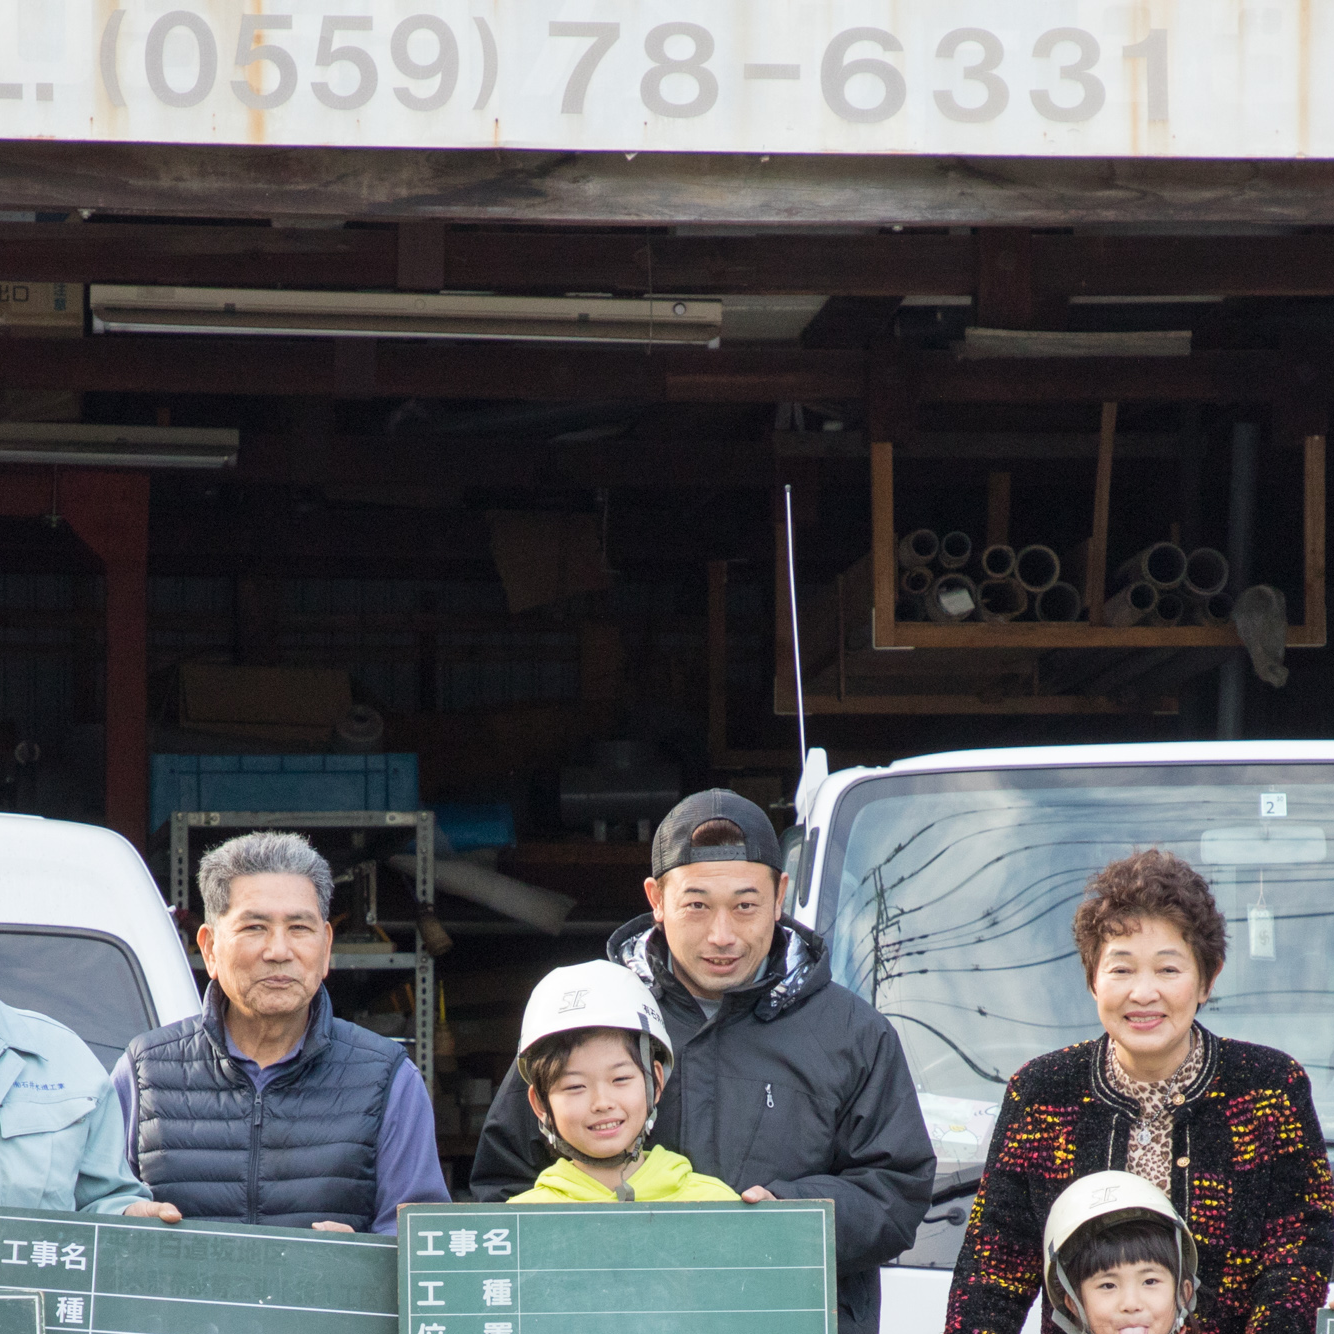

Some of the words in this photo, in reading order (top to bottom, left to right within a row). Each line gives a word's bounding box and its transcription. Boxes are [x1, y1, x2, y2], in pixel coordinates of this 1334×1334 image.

[97, 7, 501, 114] (0559)
[547, 20, 1171, 126] 78-6331
[1266, 801, 1275, 814] 2
[0, 1238, 87, 1271] 工事名
[416, 1228, 512, 1257] 工事名
